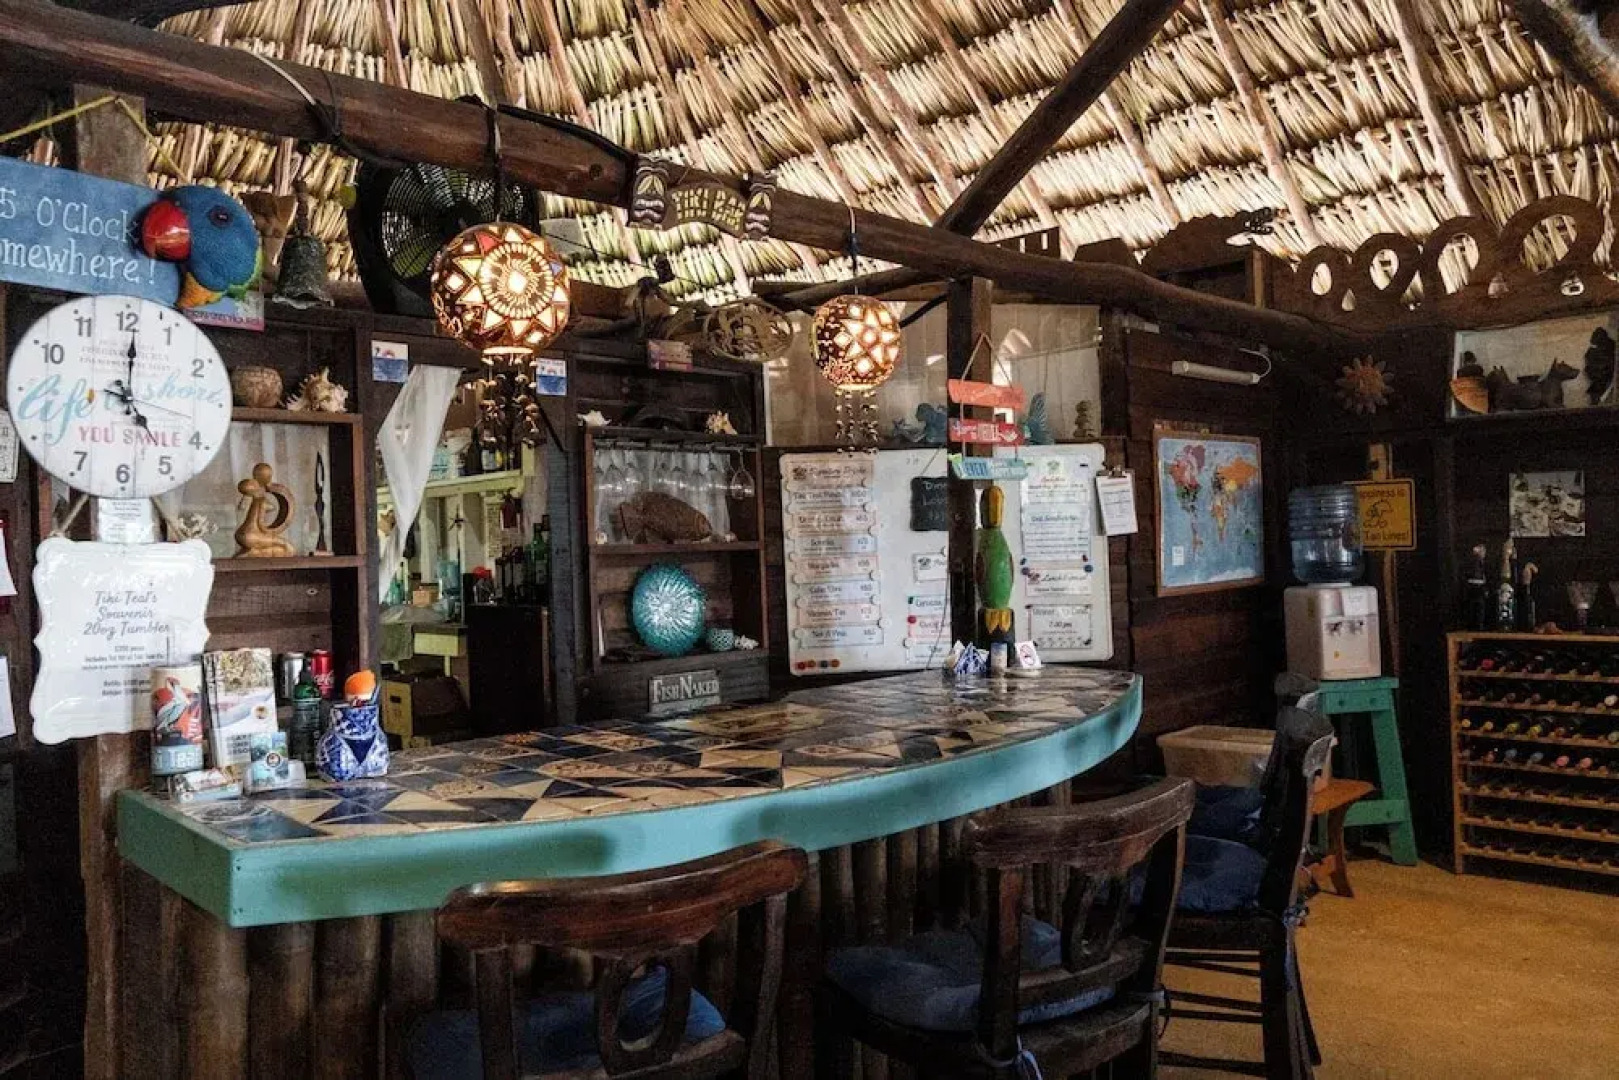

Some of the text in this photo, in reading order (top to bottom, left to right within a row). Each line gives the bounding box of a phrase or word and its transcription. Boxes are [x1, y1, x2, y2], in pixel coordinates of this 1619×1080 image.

[671, 187, 709, 220] TIKI
[0, 187, 140, 244] 5 O'Clock
[74, 316, 92, 338] 11
[116, 311, 140, 332] 12
[163, 326, 172, 346] 1
[41, 343, 64, 365] 10
[191, 358, 205, 378] 2
[79, 426, 116, 443] YOU
[188, 430, 203, 450] 4
[74, 451, 89, 471] 7
[158, 455, 172, 475] 5
[115, 464, 131, 484] 6
[94, 590, 157, 607] Tiki Teal's
[96, 606, 153, 622] Souvenir
[82, 621, 170, 641] 20oz Tumbler
